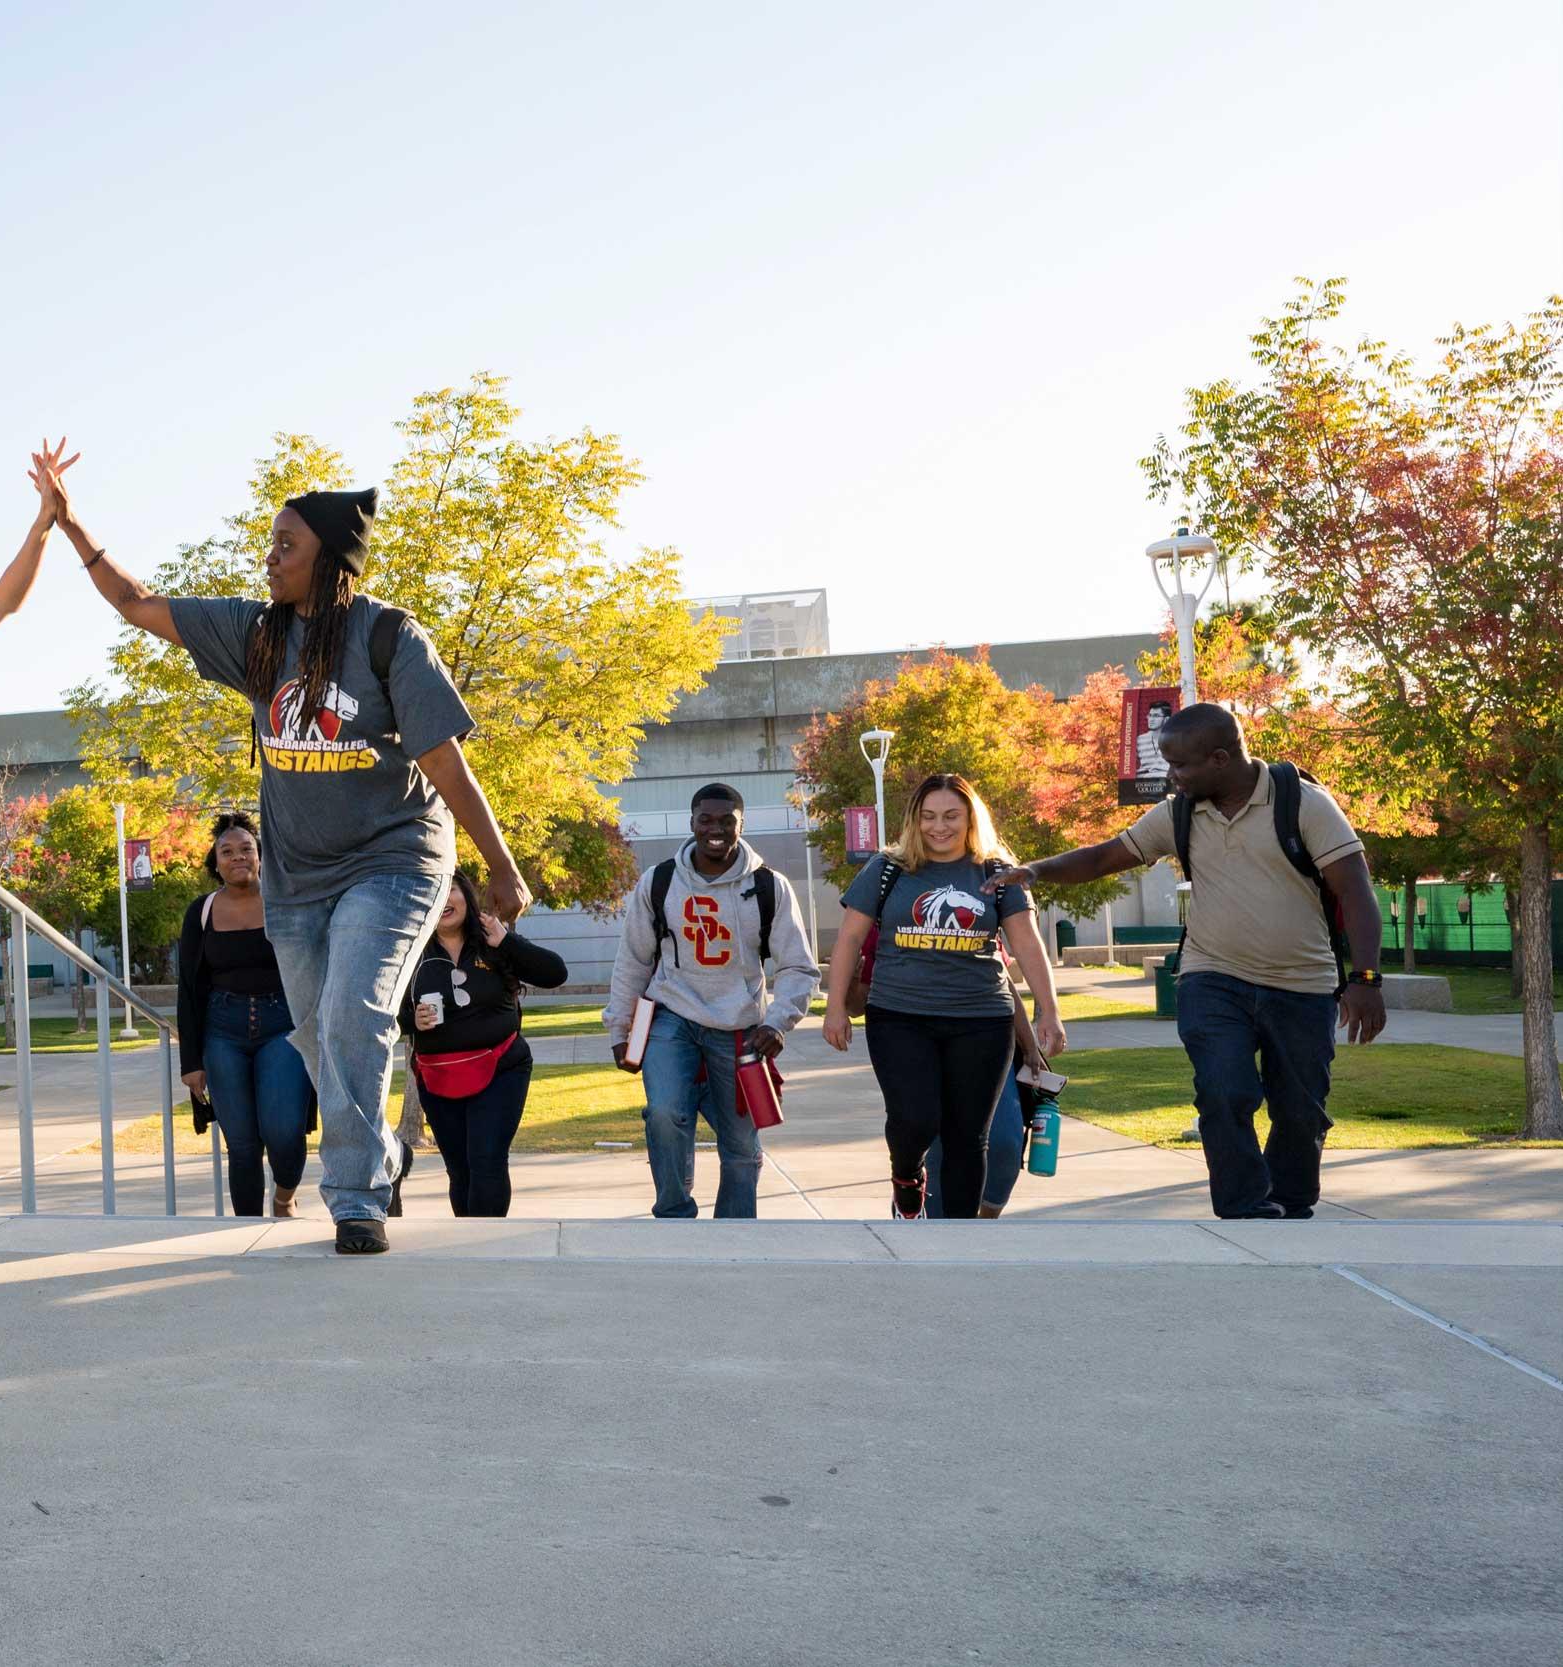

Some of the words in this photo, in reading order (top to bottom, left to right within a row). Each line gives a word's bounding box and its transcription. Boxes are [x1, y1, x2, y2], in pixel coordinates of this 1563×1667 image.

[1125, 702, 1133, 745] GOVERNMENT
[263, 744, 375, 773] USTANGS
[270, 737, 322, 751] MEDANOS
[322, 739, 368, 752] COLLEGE
[682, 896, 732, 967] SC
[897, 926, 913, 934] LOS
[913, 926, 958, 936] MEDANOS
